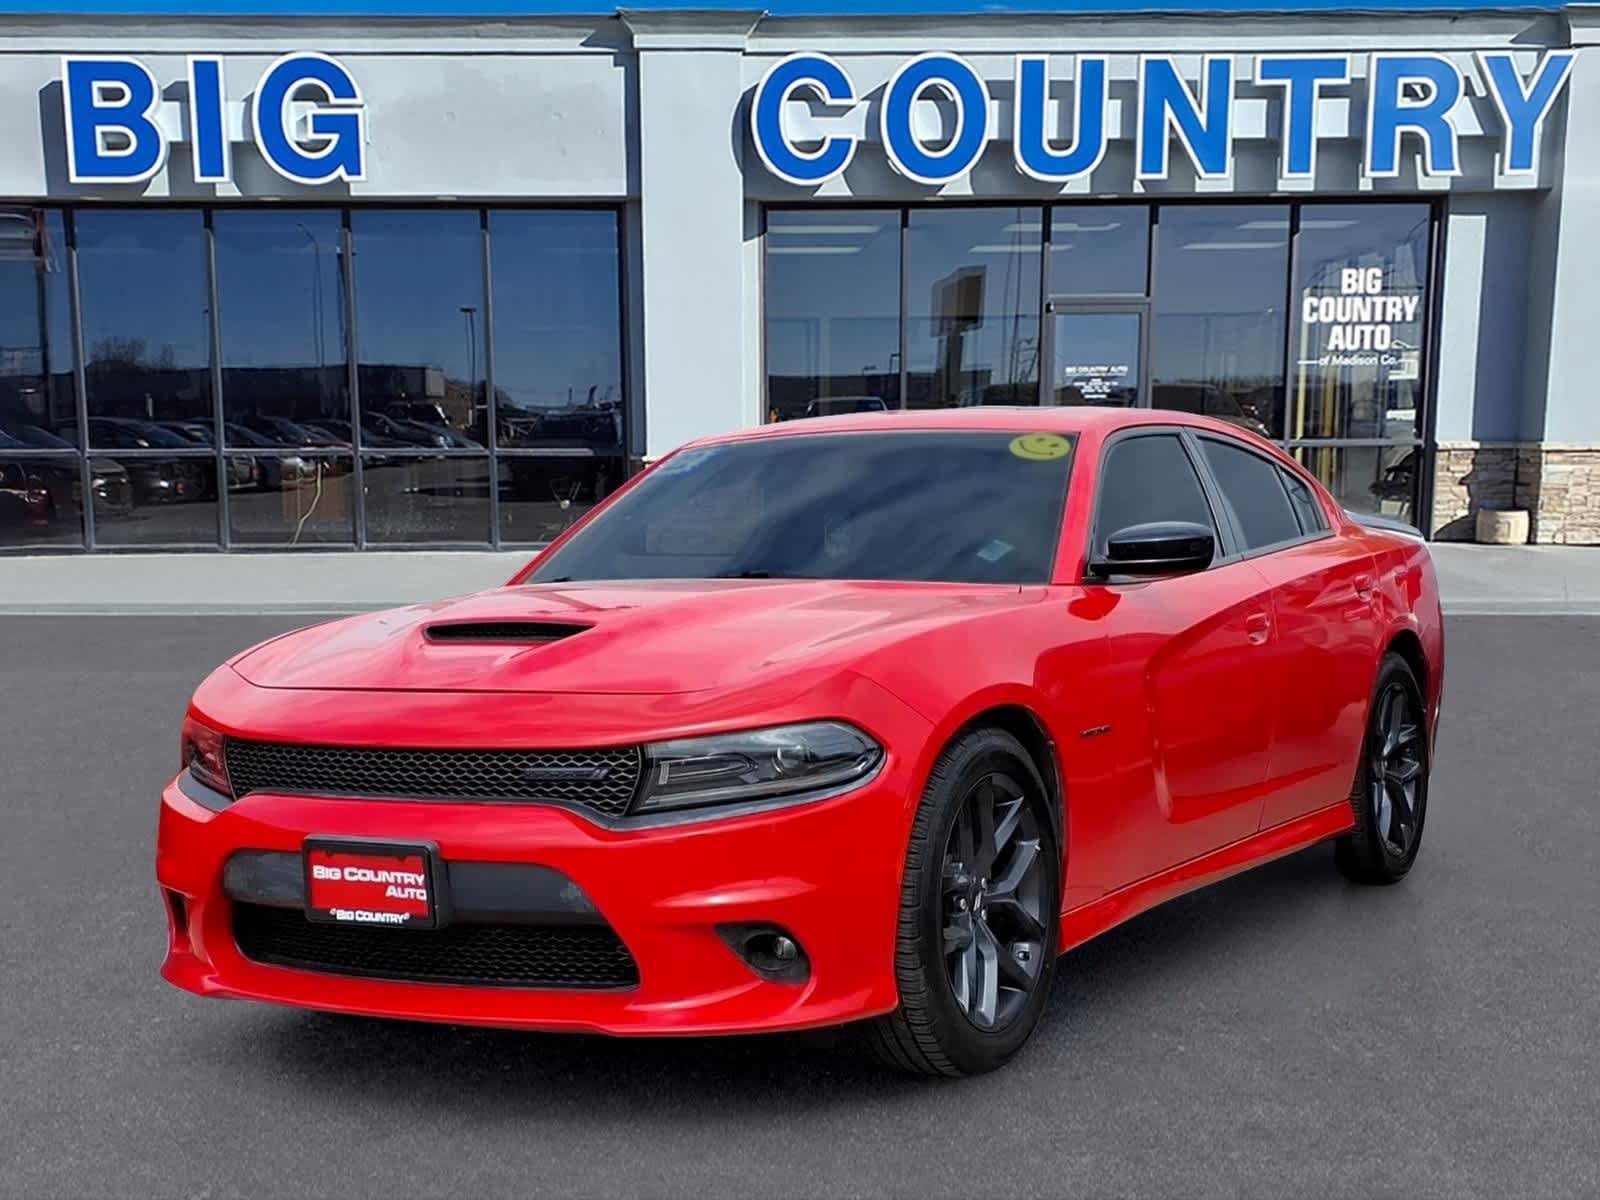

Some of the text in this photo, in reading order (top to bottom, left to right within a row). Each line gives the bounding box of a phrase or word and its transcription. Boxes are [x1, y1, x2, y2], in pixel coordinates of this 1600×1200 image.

[61, 50, 1574, 186] BIG COUNTRY
[1341, 267, 1382, 294] BIG
[1303, 296, 1419, 323] COUNTRY
[1328, 324, 1391, 351] AUTO
[1319, 356, 1329, 366] of
[1332, 354, 1377, 365] Madison
[313, 865, 425, 885] BIG COUNTRY
[385, 886, 427, 901] AUTO
